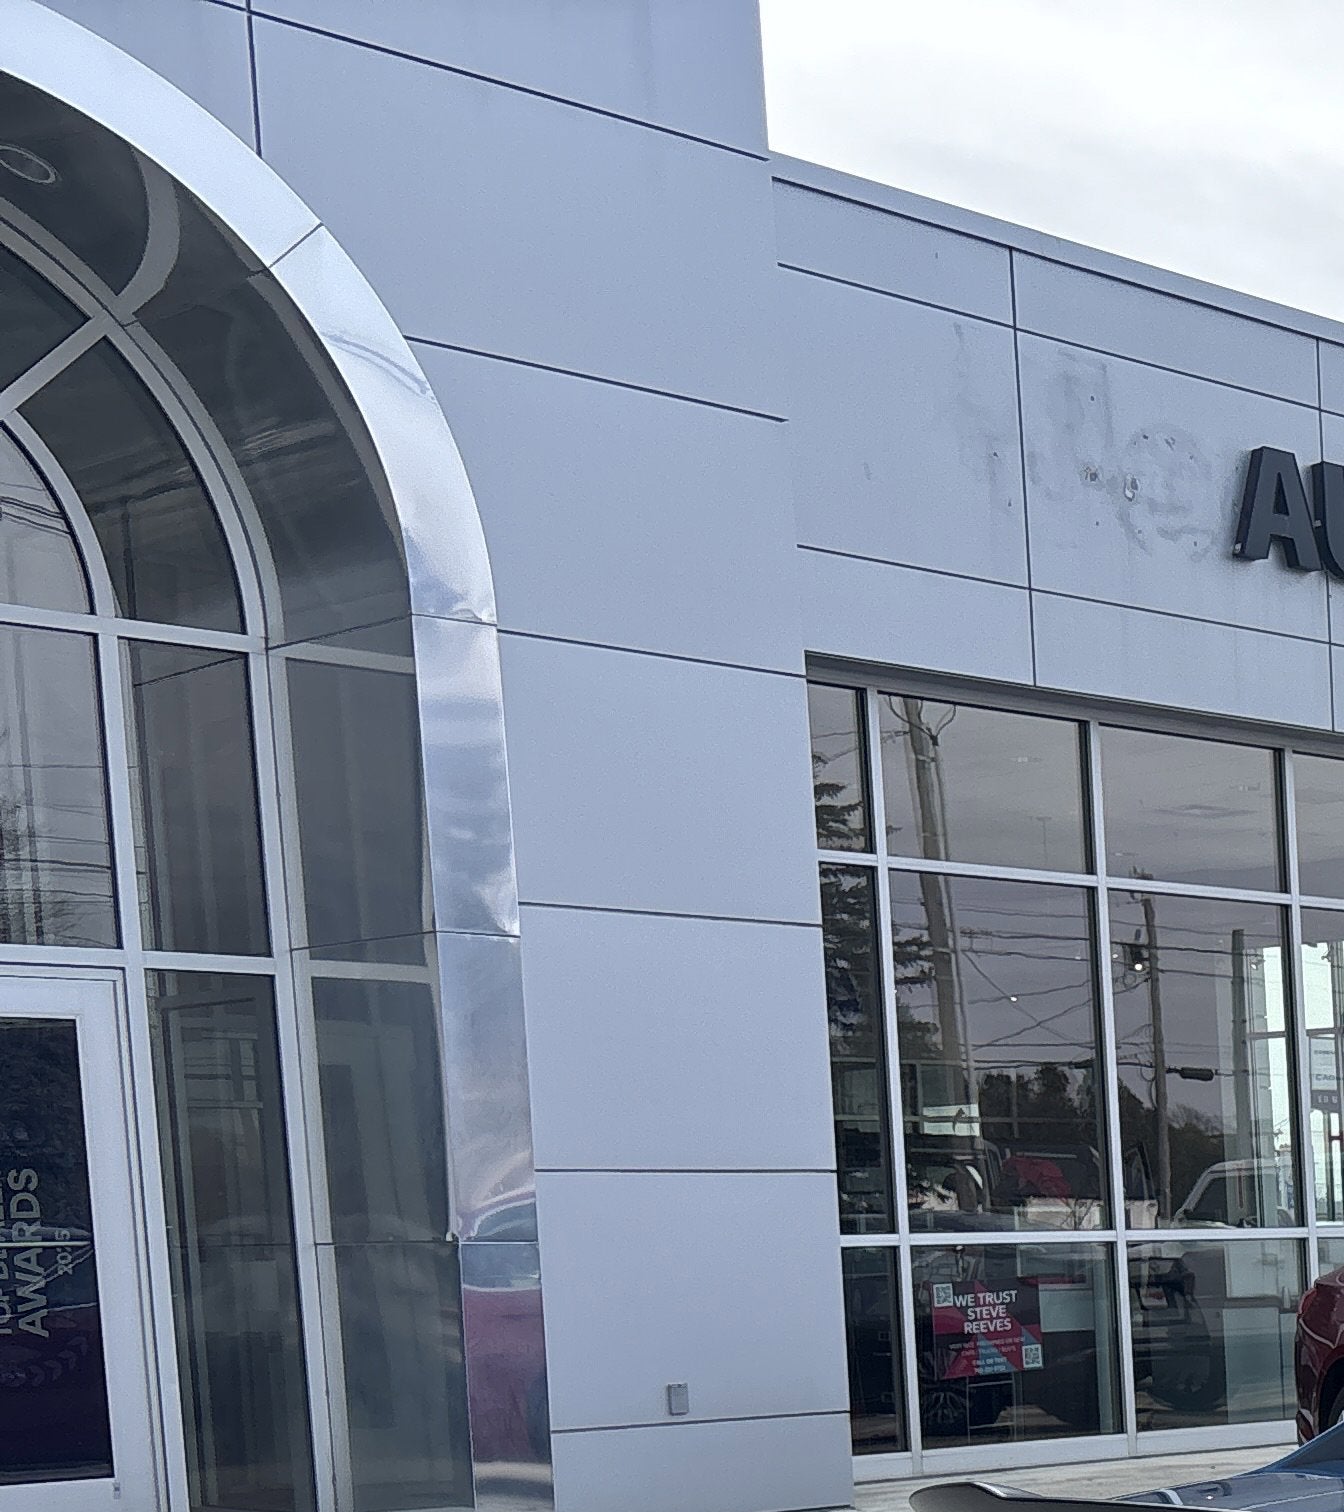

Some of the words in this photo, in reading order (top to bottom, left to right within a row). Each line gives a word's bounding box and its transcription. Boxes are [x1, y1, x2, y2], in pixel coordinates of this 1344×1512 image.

[7, 1168, 49, 1338] AWARDS
[954, 1293, 975, 1307] WE
[977, 1290, 1017, 1306] TRUST
[967, 1305, 1007, 1320] STEVE
[963, 1318, 1012, 1334] REEVES
